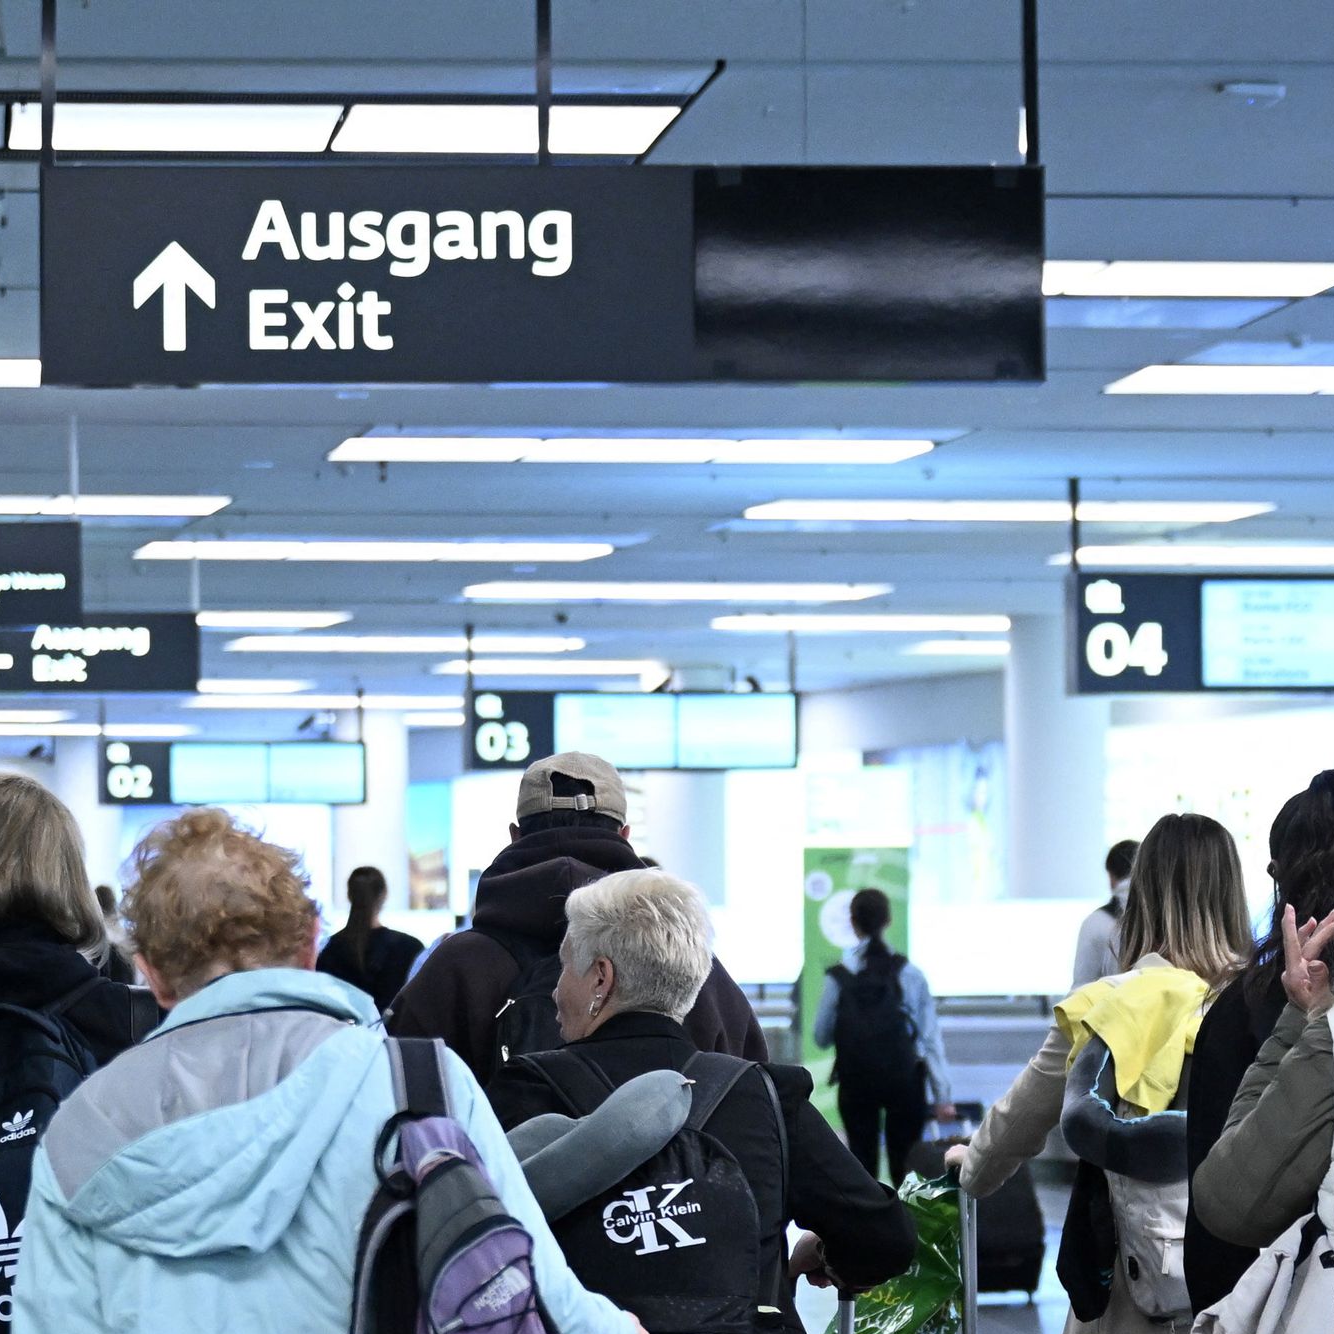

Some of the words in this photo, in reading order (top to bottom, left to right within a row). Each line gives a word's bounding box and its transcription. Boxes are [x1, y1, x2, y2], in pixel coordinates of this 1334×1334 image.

[241, 199, 573, 277] Ausgang
[248, 281, 394, 351] Exit
[1085, 621, 1169, 677] 04
[474, 721, 531, 762] 03
[107, 763, 154, 799] 02
[0, 1126, 37, 1144] adidas
[603, 1211, 657, 1230] Calvin
[660, 1201, 702, 1219] Klein
